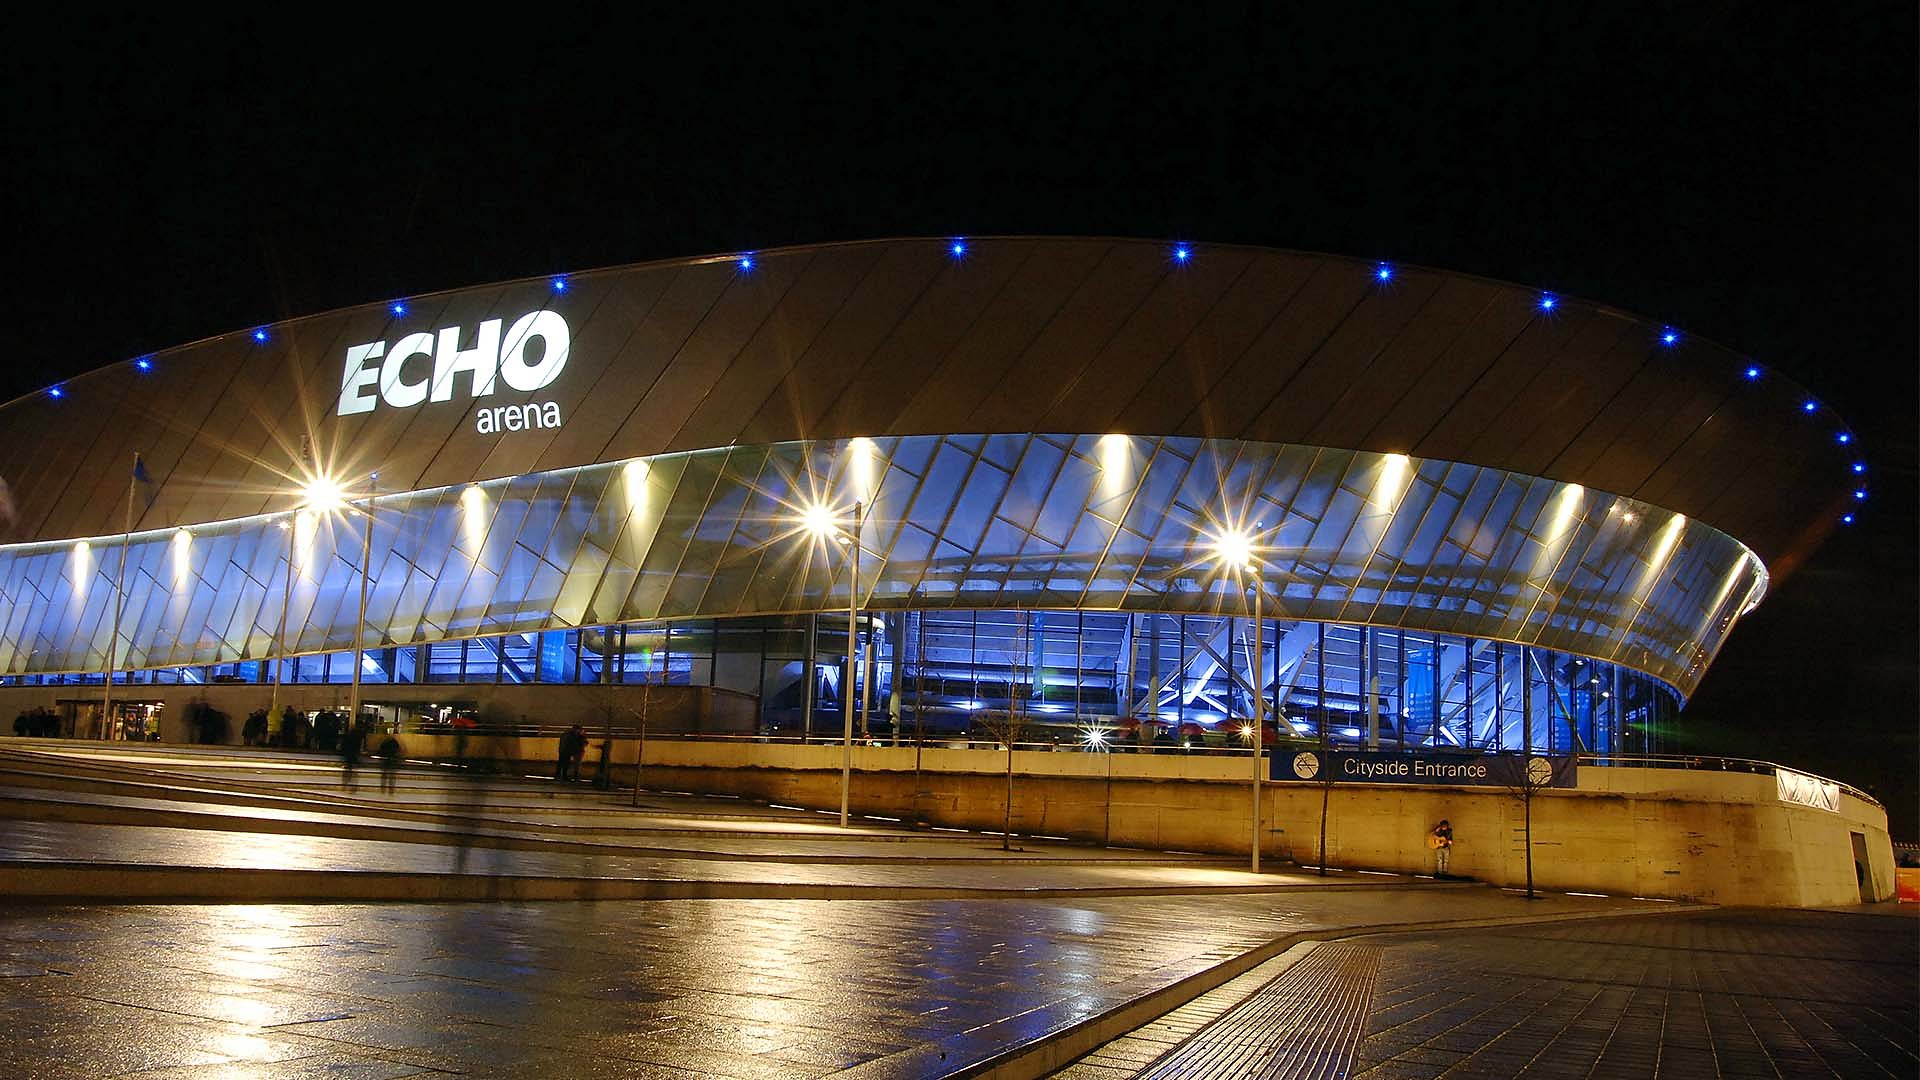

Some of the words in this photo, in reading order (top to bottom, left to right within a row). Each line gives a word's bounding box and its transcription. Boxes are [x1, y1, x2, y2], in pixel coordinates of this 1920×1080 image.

[337, 310, 570, 416] ECHO
[477, 401, 561, 434] arena
[1344, 758, 1408, 778] Cityside
[1415, 760, 1487, 778] Entrance
